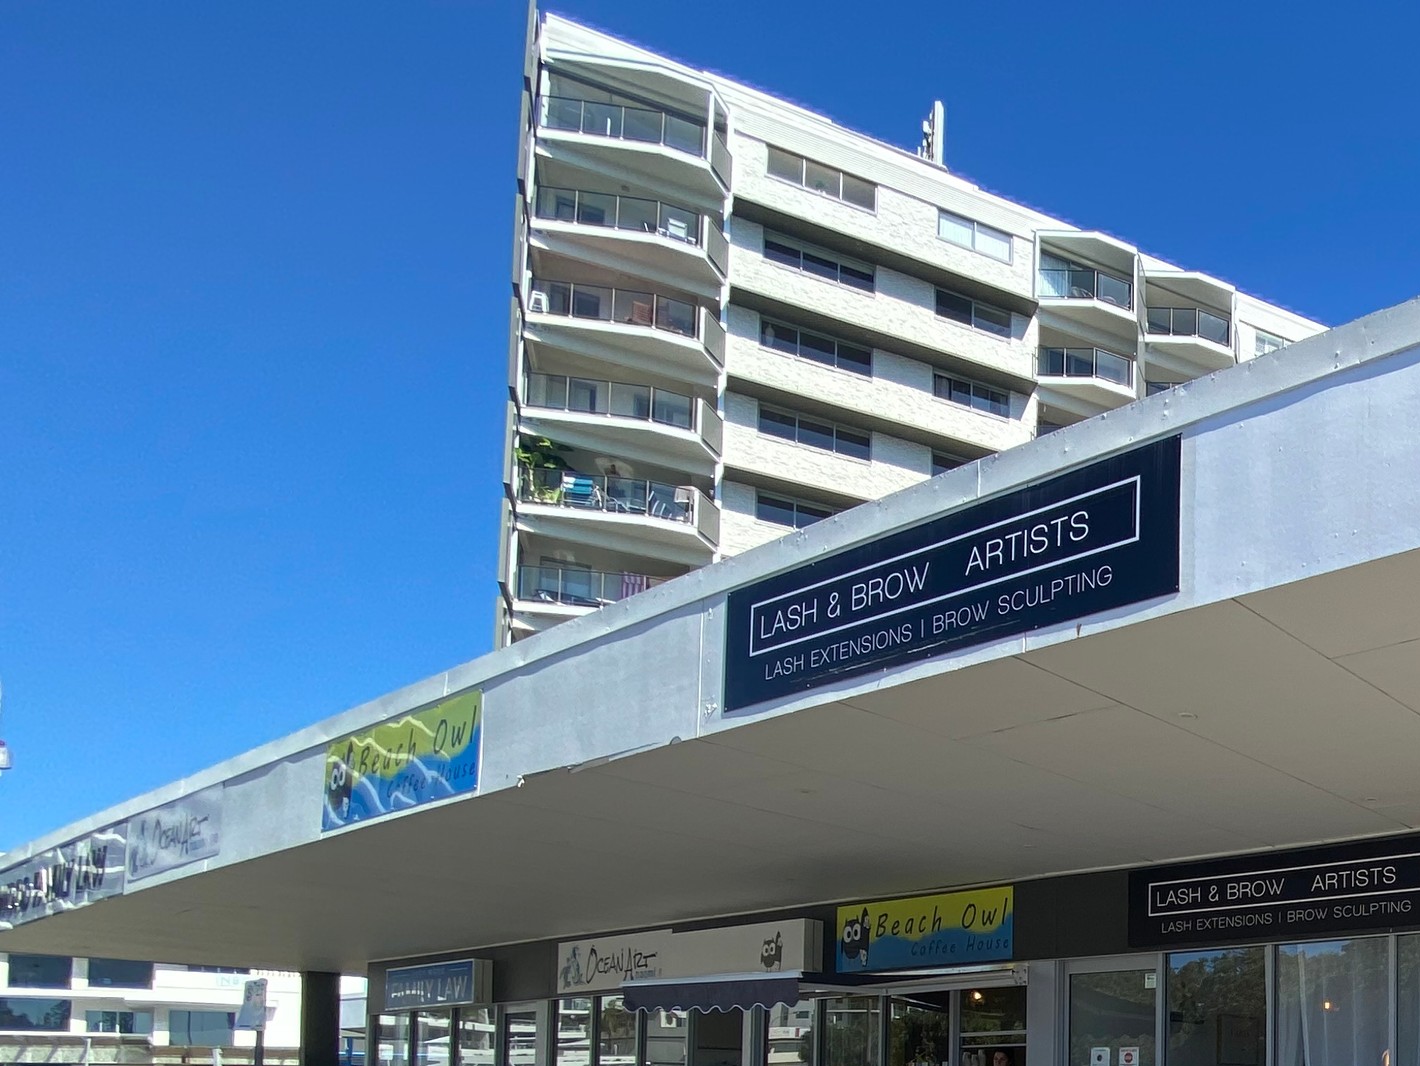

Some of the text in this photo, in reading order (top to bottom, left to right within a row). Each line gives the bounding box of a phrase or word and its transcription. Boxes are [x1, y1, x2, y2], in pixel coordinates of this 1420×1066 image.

[760, 510, 1090, 640] LASH & BROW ARTISTS
[765, 654, 805, 681] LASH
[810, 624, 914, 667] EXTENSIONS
[932, 601, 990, 634] BROW
[997, 565, 1114, 615] SCULPTING
[358, 705, 477, 774] Beach Owl
[1156, 866, 1397, 907] LASH & BROW ARTISTS
[875, 897, 1009, 938] Beach Owl
[1161, 920, 1192, 933] LASH
[1196, 911, 1273, 931] EXTENSIONS
[1287, 906, 1328, 923] BROW
[1333, 899, 1412, 919] SCULPTING
[910, 934, 1010, 956] Coffee House
